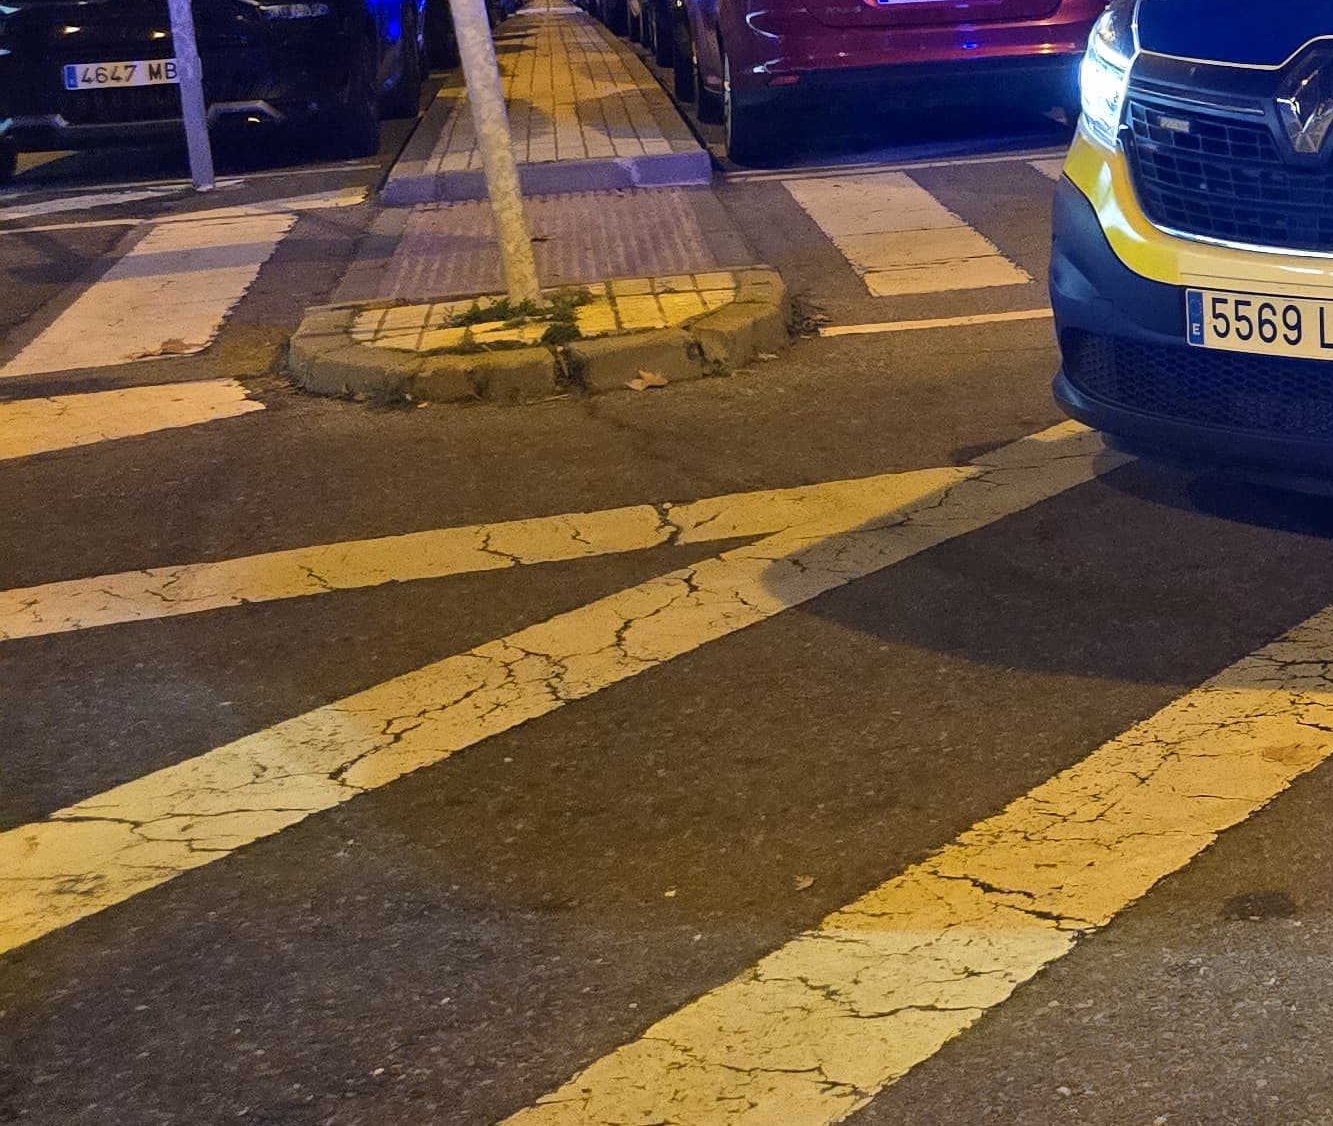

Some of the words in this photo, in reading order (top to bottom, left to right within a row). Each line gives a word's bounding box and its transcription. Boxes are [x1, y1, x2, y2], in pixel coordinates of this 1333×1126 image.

[81, 65, 137, 83] 4647
[148, 62, 178, 80] MB
[1192, 324, 1201, 335] E
[1211, 297, 1302, 345] 5569
